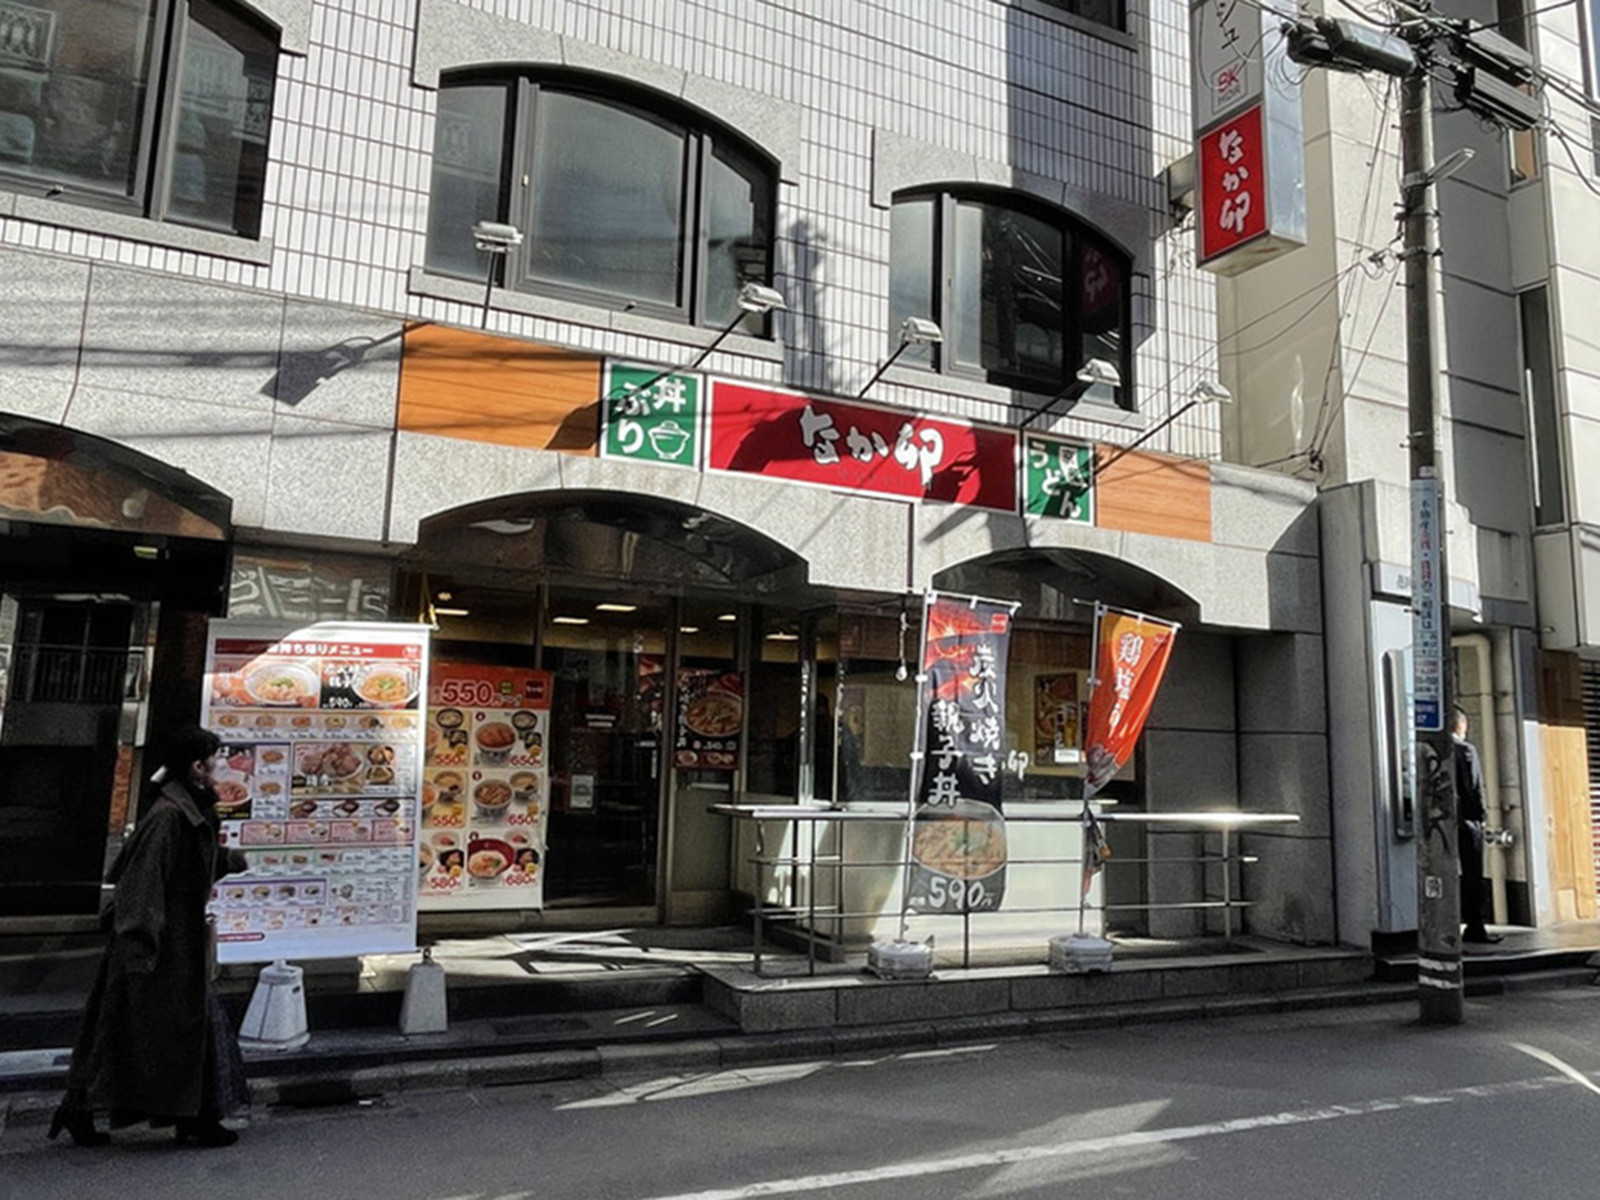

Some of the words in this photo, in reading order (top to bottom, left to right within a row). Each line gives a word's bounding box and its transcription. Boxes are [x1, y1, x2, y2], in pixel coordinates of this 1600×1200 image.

[1218, 129, 1251, 234] なか卯
[799, 404, 944, 488] なか卯
[1001, 750, 1029, 781] 卯
